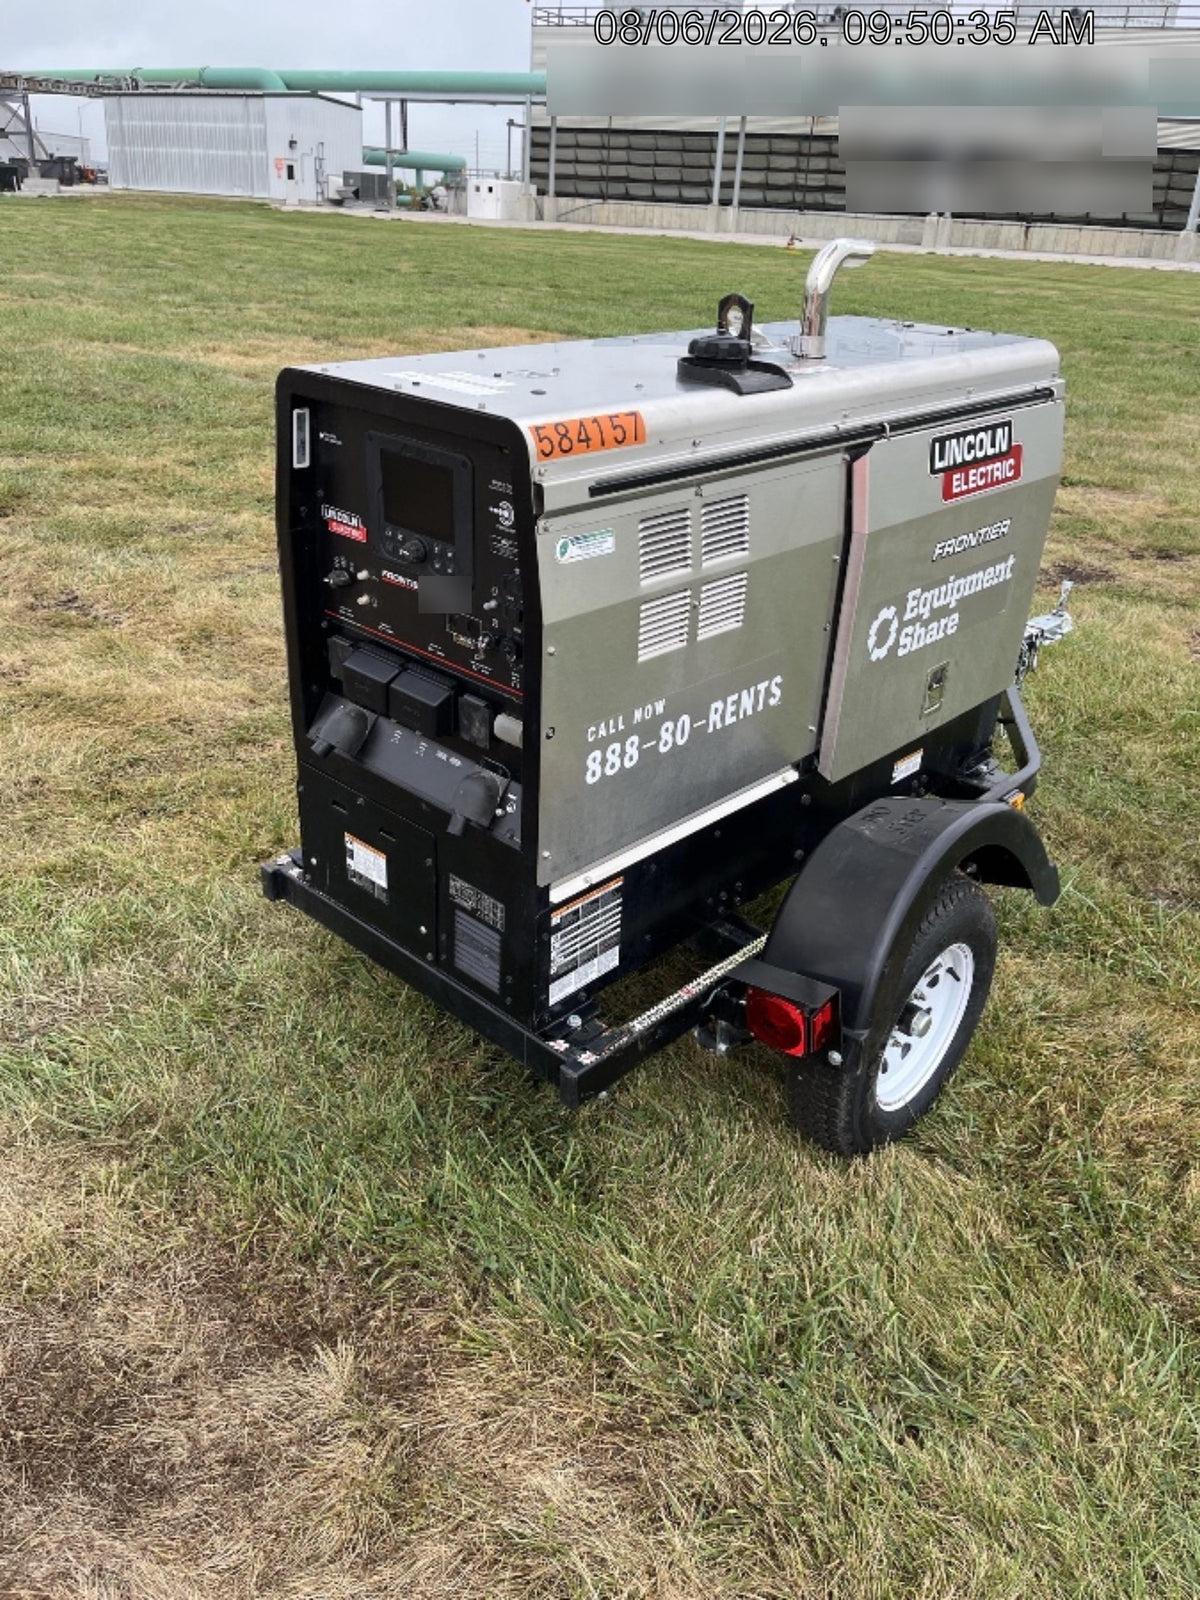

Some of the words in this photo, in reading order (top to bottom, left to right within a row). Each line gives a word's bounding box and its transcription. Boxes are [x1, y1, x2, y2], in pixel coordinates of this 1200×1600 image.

[534, 411, 639, 458] 584157
[934, 426, 1009, 470] LINCOLN
[952, 458, 1015, 493] ELECTRIC
[932, 518, 1012, 562] FRONTIER
[903, 554, 1016, 621] Equipment
[897, 612, 960, 657] Share
[585, 675, 783, 785] 888-80-RENTS
[587, 715, 625, 742] CALL
[633, 698, 666, 725] NOW
